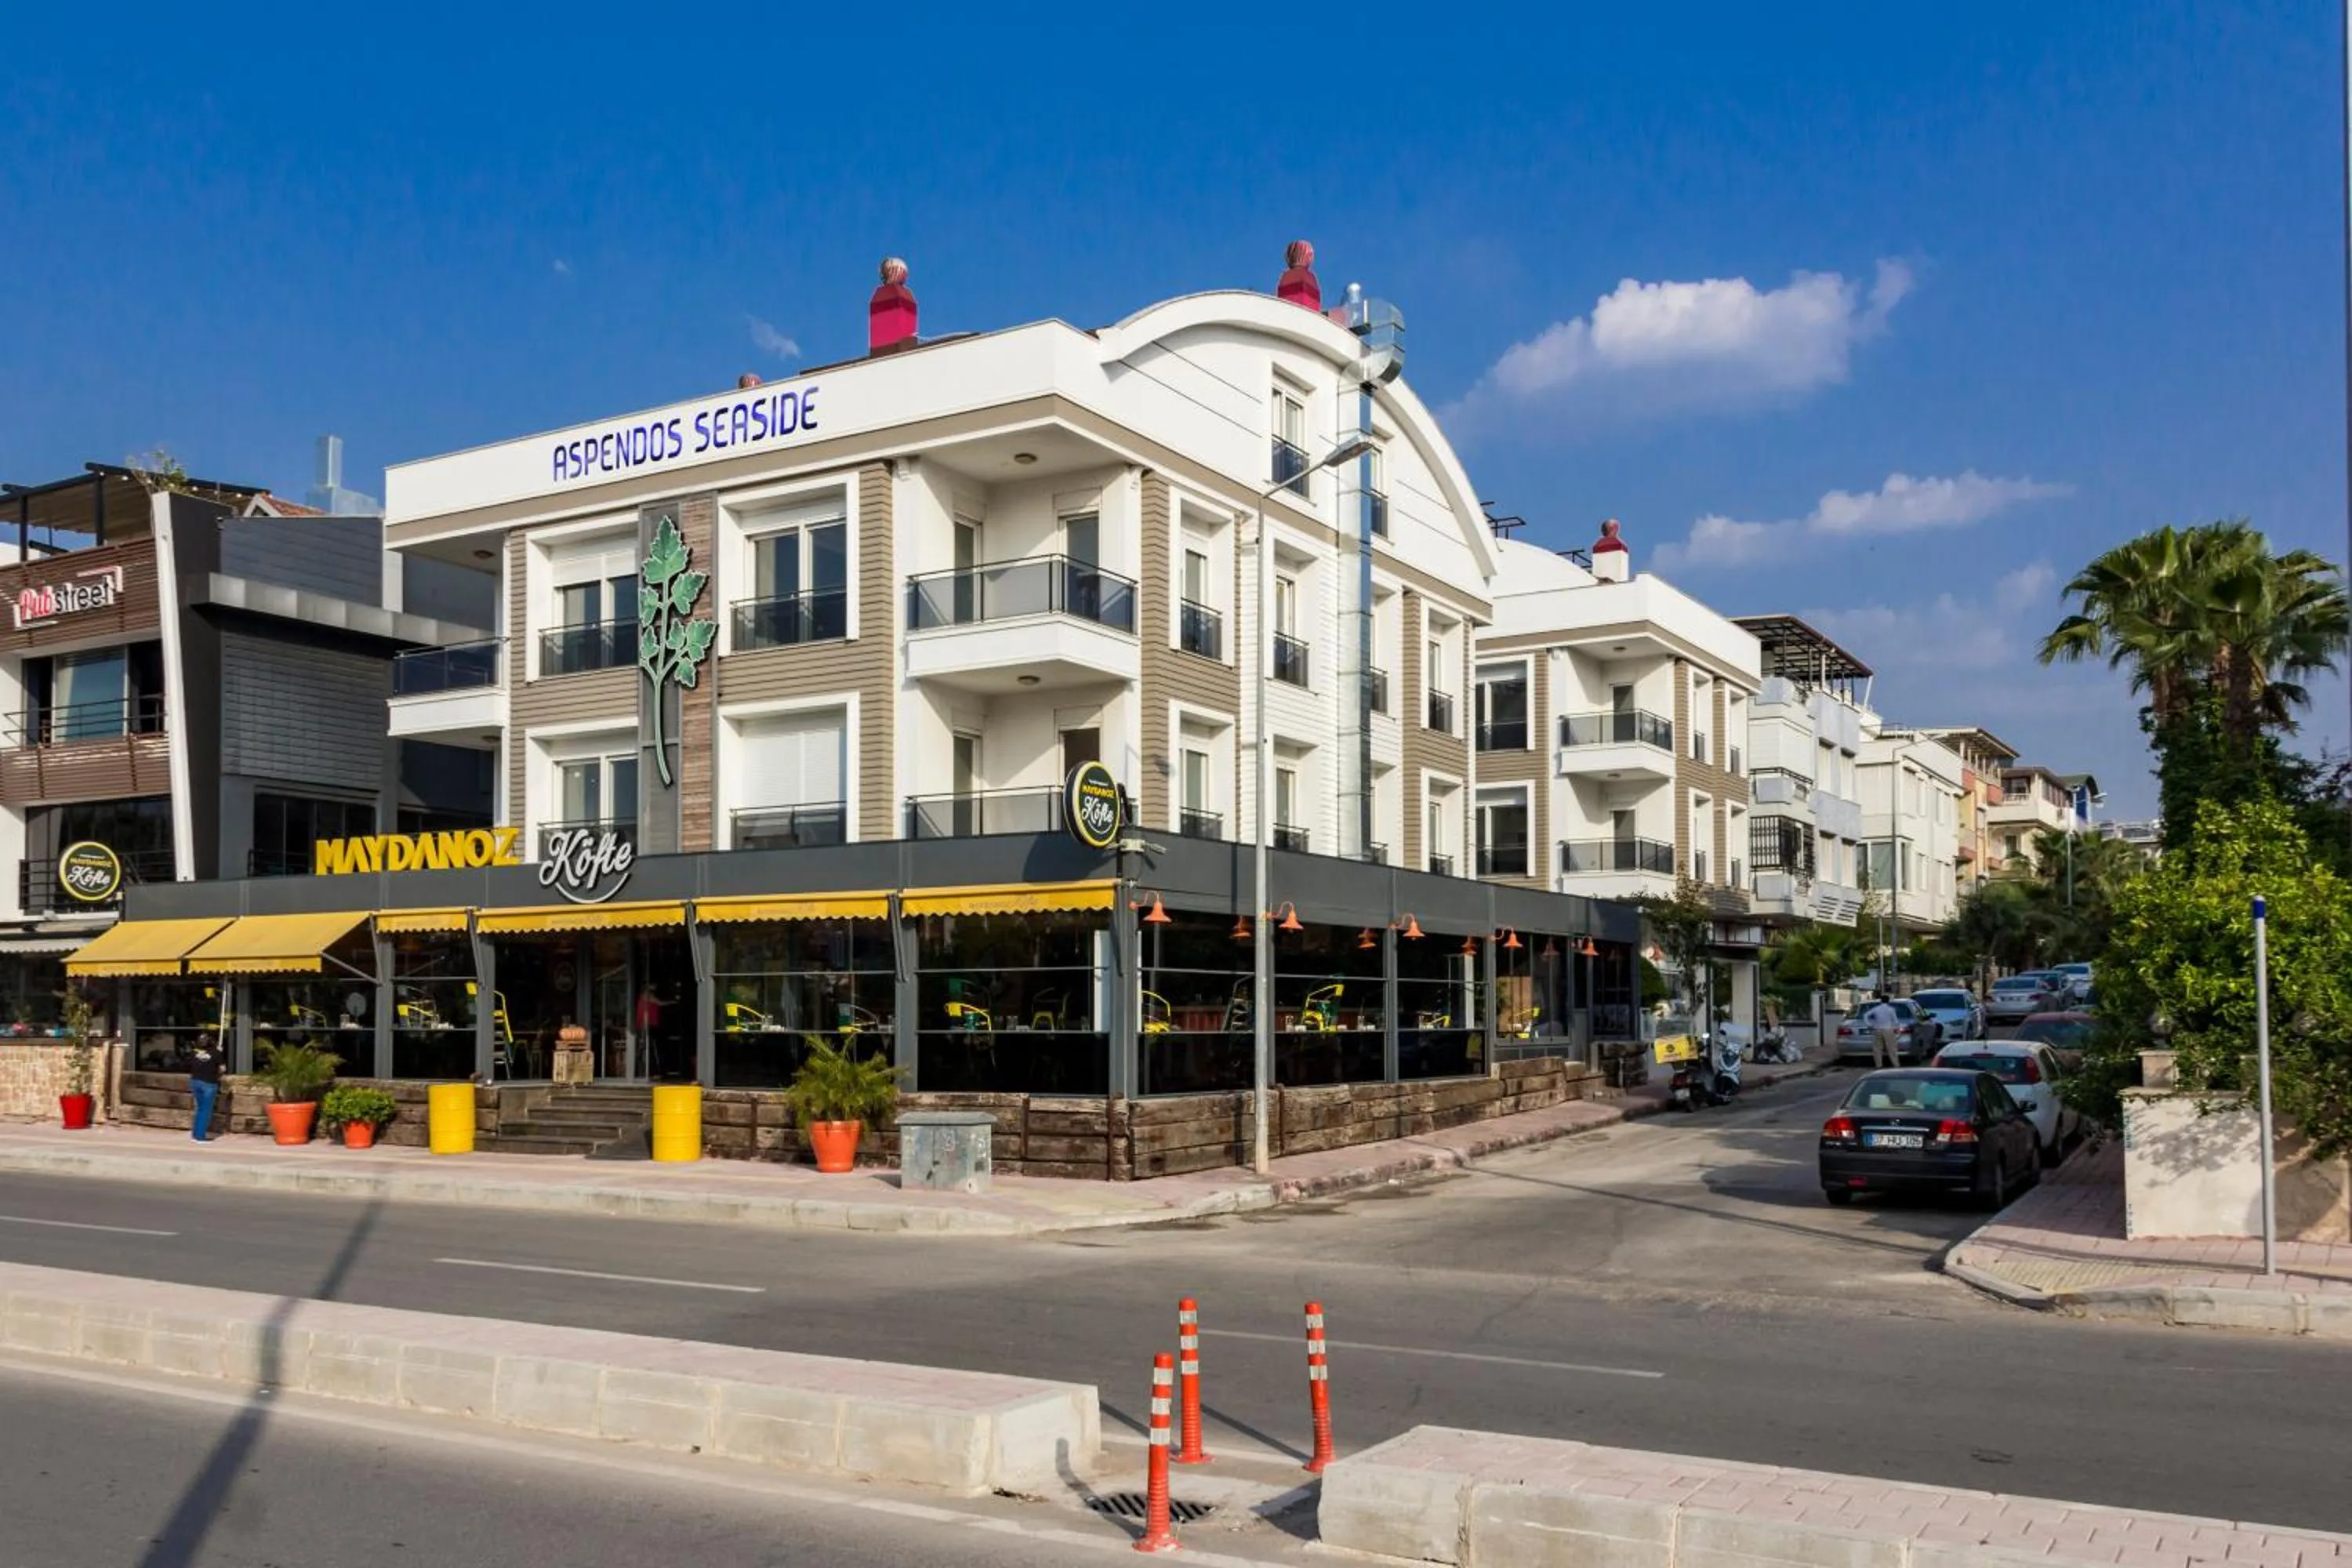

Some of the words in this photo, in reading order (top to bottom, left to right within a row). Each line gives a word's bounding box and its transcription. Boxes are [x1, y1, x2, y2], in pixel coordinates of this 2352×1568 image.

[553, 418, 683, 482] ASPENDOS
[695, 386, 819, 453] SEASIDE
[315, 827, 521, 876] MAYDANOZ
[539, 829, 631, 888] Köfte
